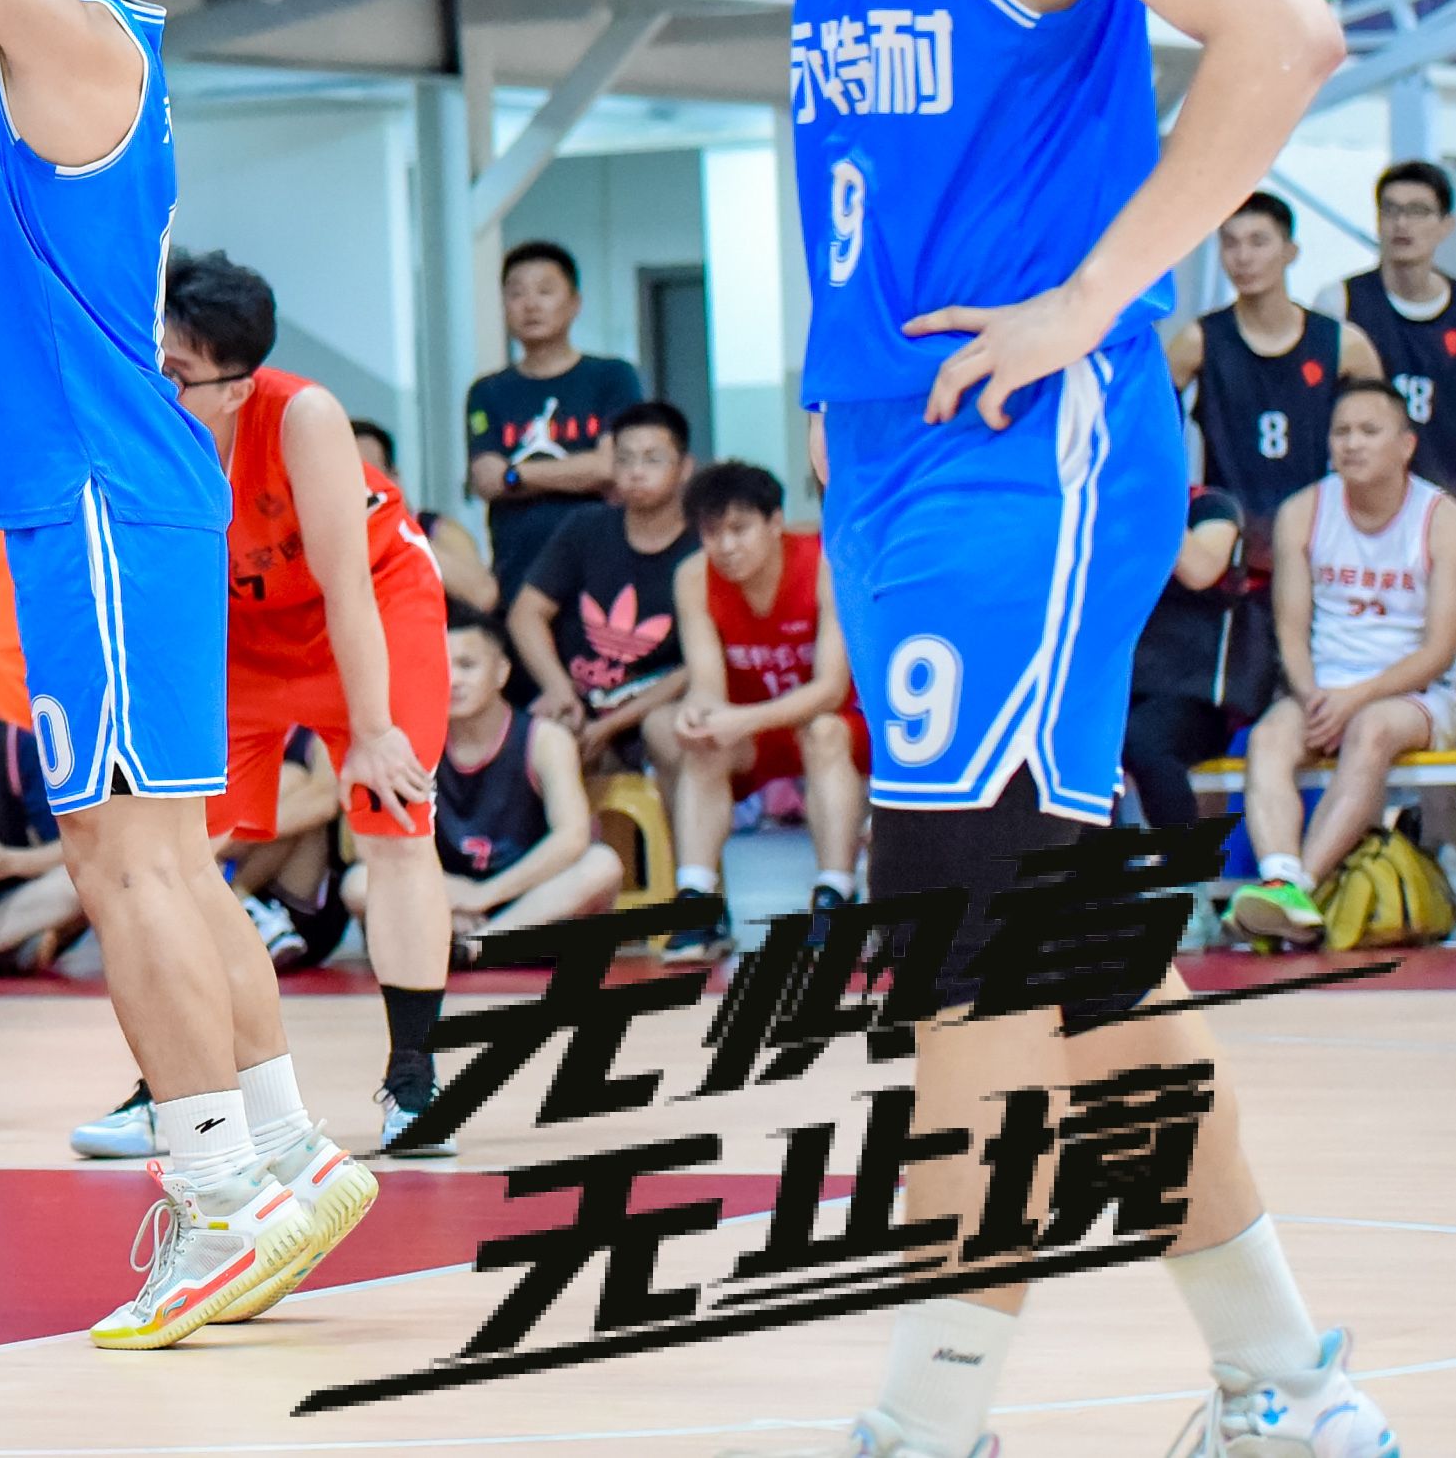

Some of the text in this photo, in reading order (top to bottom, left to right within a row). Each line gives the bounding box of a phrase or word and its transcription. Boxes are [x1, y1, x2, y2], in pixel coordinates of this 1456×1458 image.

[791, 9, 953, 124] 永特耐
[829, 158, 865, 287] 9
[1258, 410, 1289, 459] 8
[886, 634, 963, 766] 9
